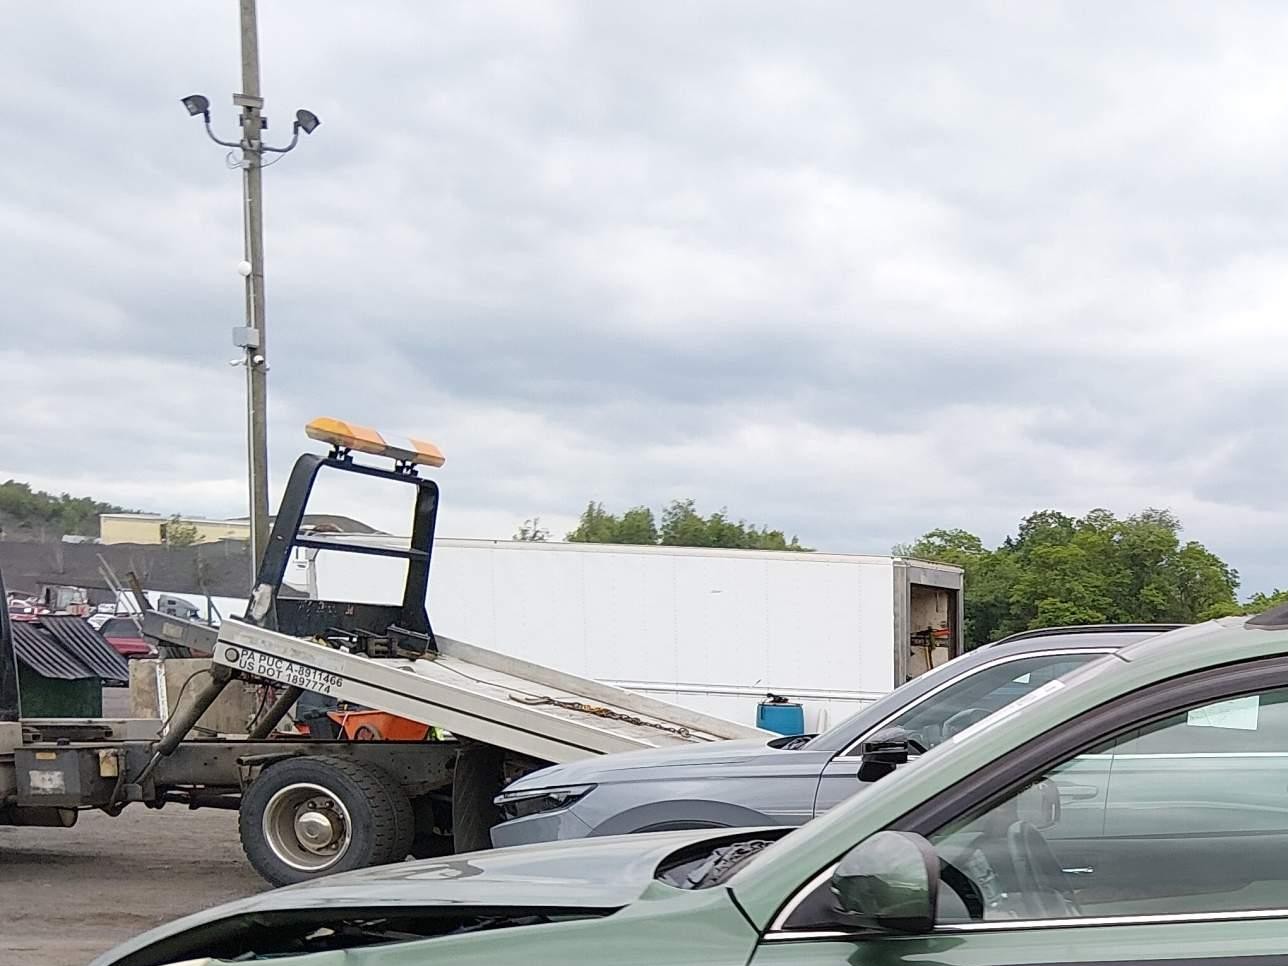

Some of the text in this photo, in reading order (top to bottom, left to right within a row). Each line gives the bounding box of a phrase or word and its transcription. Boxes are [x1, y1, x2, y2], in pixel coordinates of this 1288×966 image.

[239, 659, 331, 694] US DOT 1897774
[240, 649, 343, 688] PA PUC A-8911466
